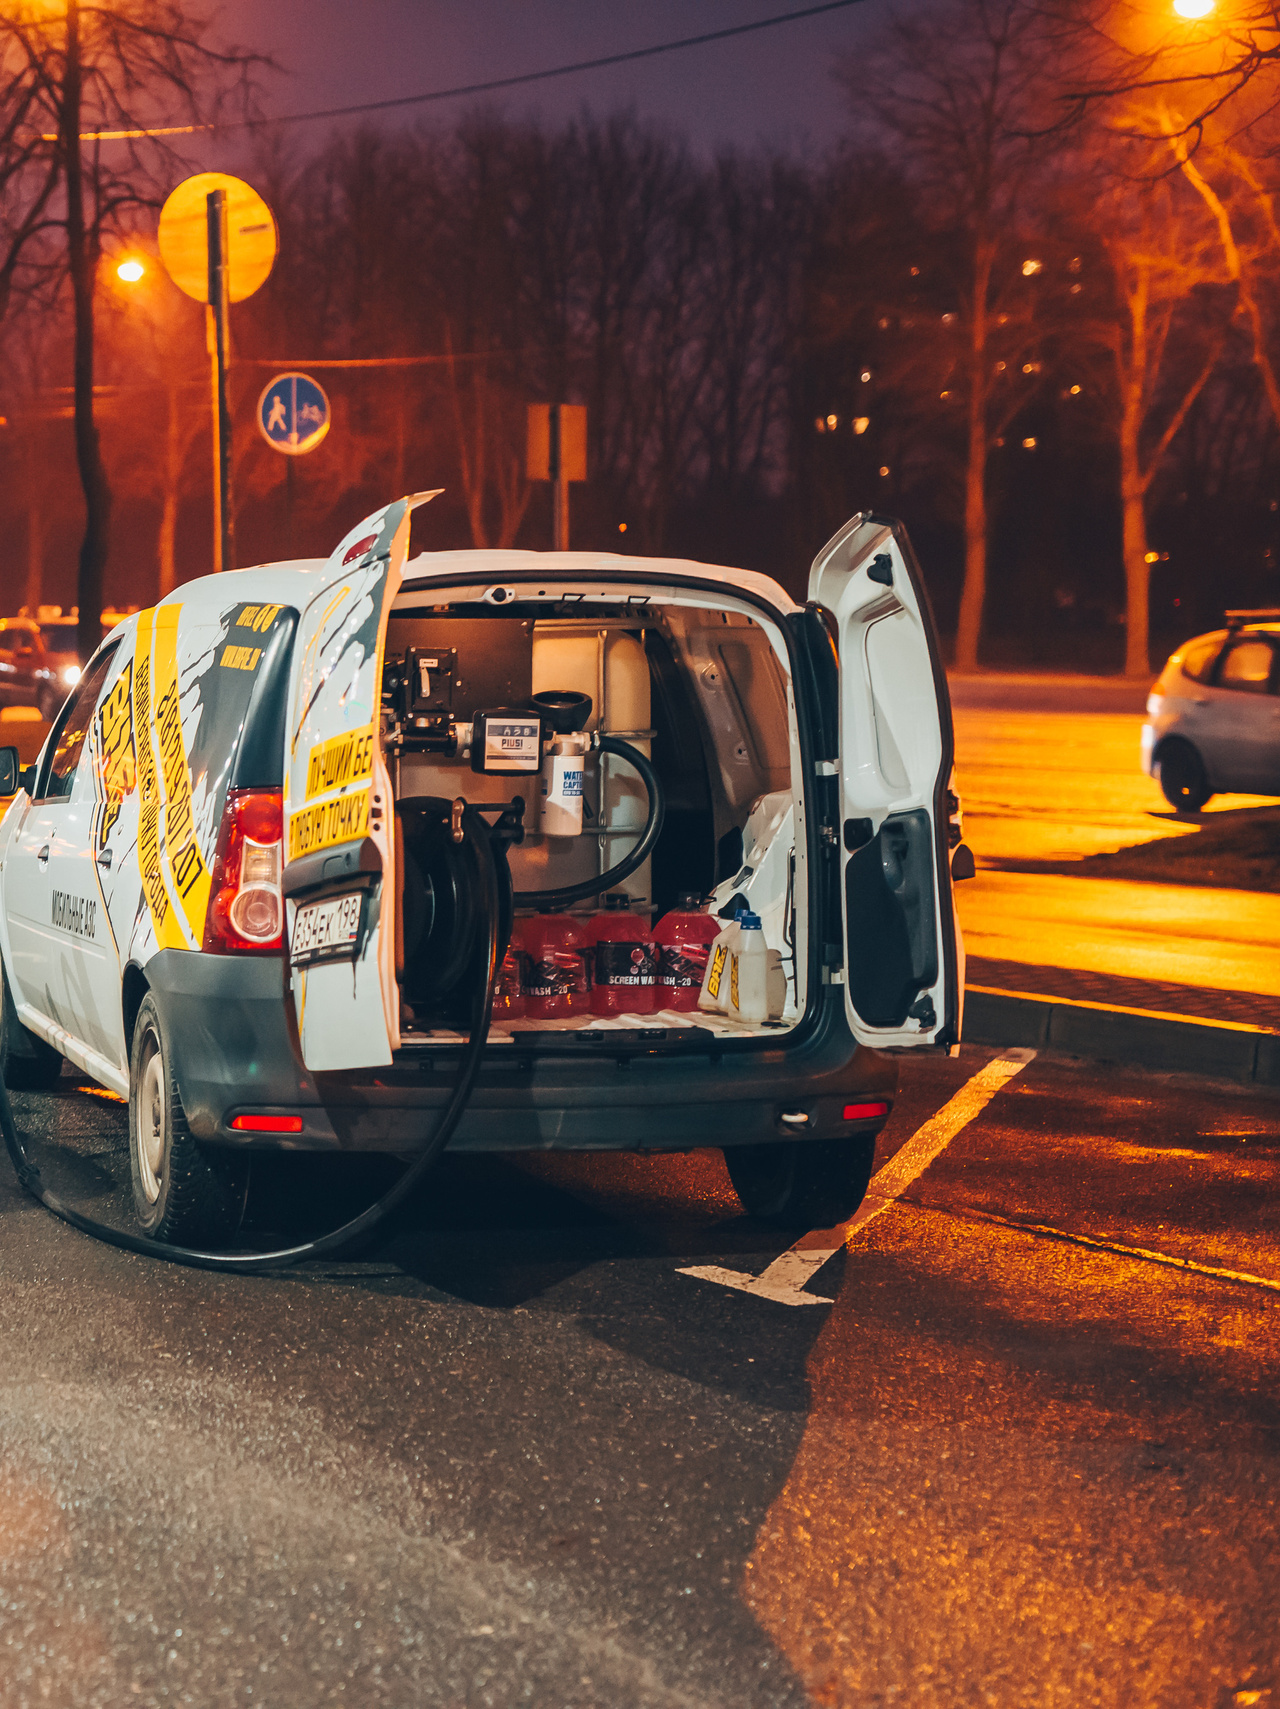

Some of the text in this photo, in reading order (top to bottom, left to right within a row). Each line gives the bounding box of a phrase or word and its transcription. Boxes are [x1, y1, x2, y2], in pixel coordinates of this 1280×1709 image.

[501, 738, 523, 747] PIUSI
[327, 794, 366, 841] ТОЧКУ
[172, 827, 203, 899] 207
[142, 842, 169, 926] ГОРОДА
[338, 898, 358, 930] 198
[608, 975, 640, 985] SCREEN
